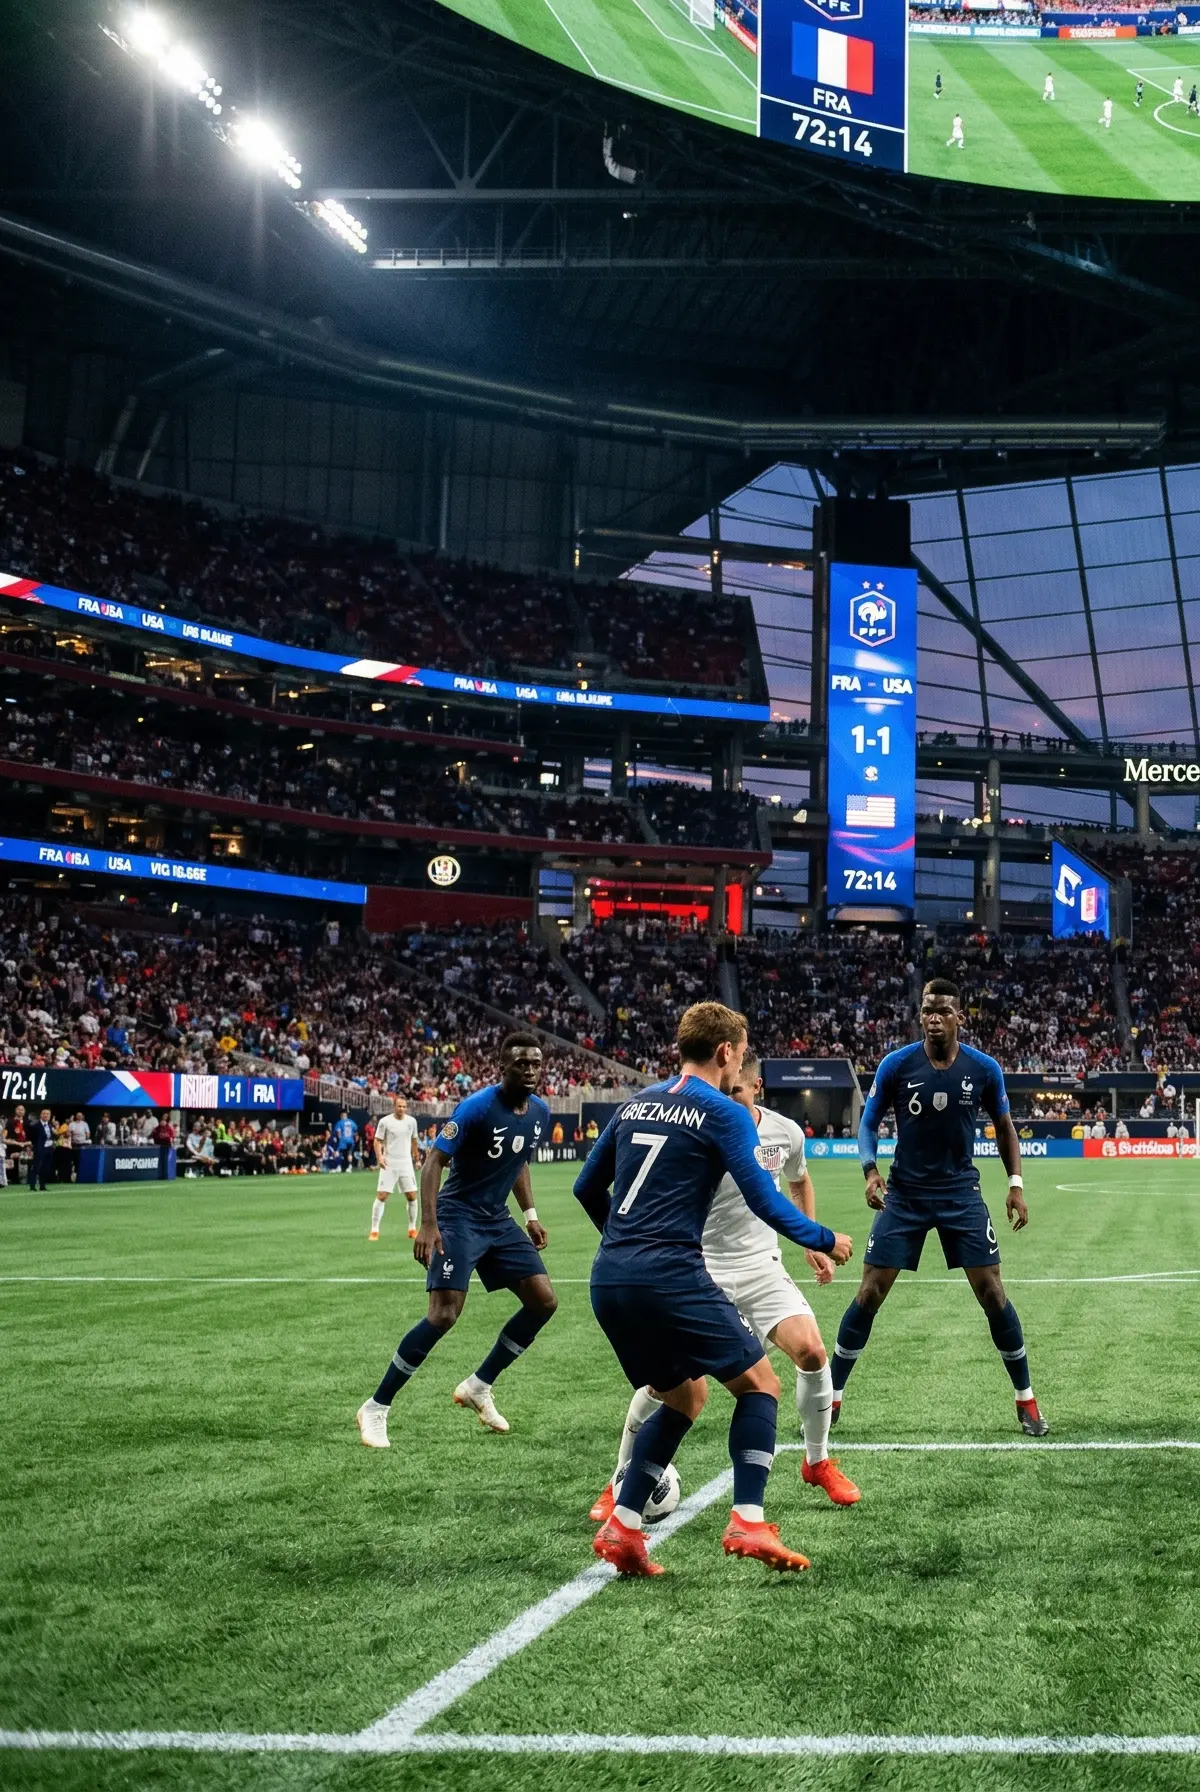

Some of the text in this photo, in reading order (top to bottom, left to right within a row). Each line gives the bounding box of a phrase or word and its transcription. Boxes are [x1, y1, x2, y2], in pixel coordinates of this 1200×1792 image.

[812, 87, 852, 114] FRA
[792, 112, 873, 157] 72:14
[141, 613, 165, 630] USA
[831, 674, 862, 692] FRA
[882, 677, 913, 694] USA
[851, 725, 890, 755] 1-1
[108, 856, 132, 871] USA
[843, 870, 897, 891] 72:14
[1, 1071, 48, 1101] 72:14
[253, 1084, 276, 1103] FRA
[621, 1102, 707, 1130] GRIEZMANN
[908, 1092, 923, 1116] 6
[487, 1136, 505, 1158] 3
[617, 1132, 669, 1215] 7
